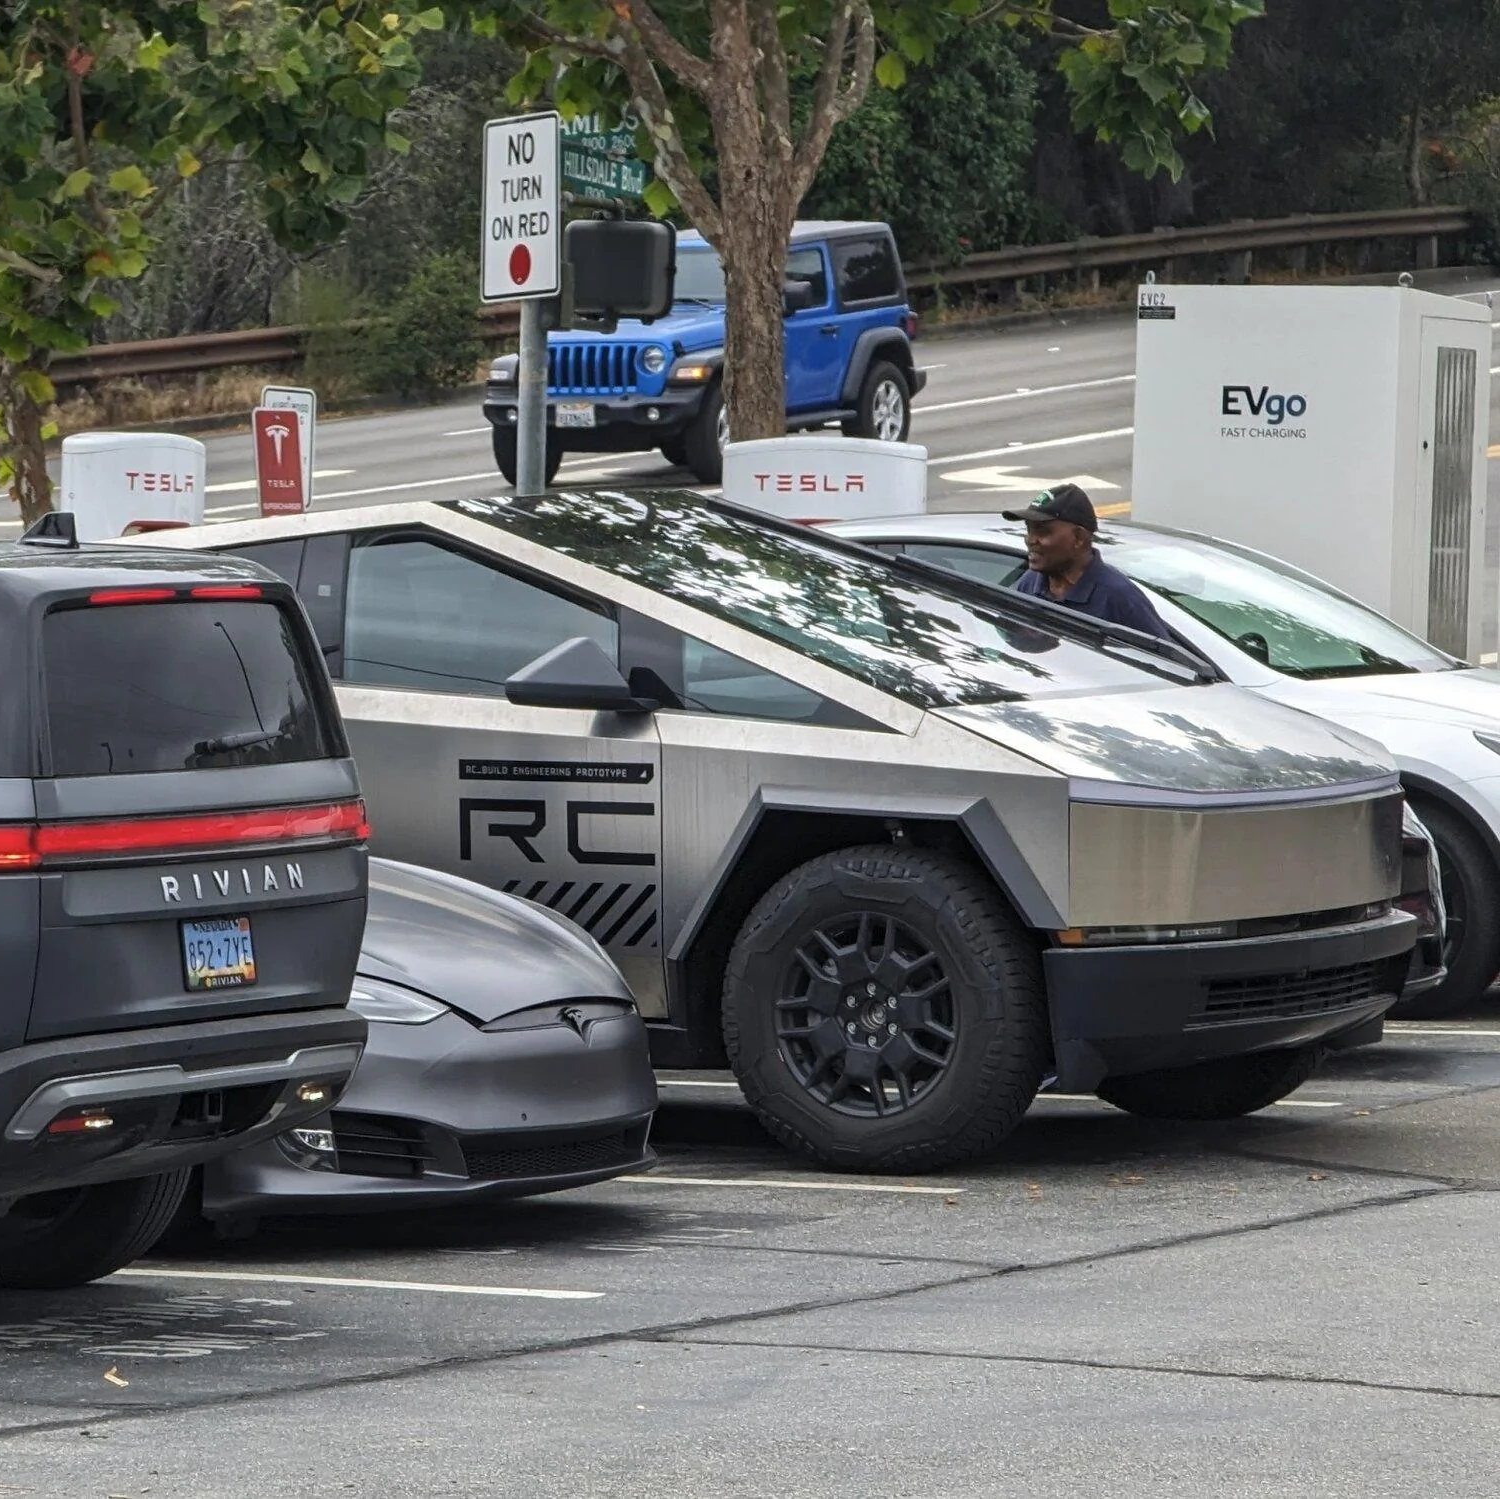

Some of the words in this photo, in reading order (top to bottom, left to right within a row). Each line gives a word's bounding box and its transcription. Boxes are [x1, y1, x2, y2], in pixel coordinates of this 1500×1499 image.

[508, 132, 535, 166] NO
[564, 151, 617, 188] HILLSDALE
[501, 175, 542, 203] TURN
[492, 216, 513, 241] ON
[519, 211, 550, 238] RED
[1140, 292, 1166, 306] EVC2
[1222, 385, 1307, 425] EVgo
[1221, 427, 1246, 438] FAST
[1249, 427, 1307, 438] CHARGING
[126, 472, 194, 493] TESLA
[267, 479, 295, 488] TESLA
[754, 474, 864, 492] TESLA
[513, 766, 571, 777] ENGINEERING
[576, 768, 627, 778] PROTOTYPE
[459, 798, 656, 866] RC
[160, 863, 304, 903] RIVIAN
[211, 976, 242, 987] RIVIAN
